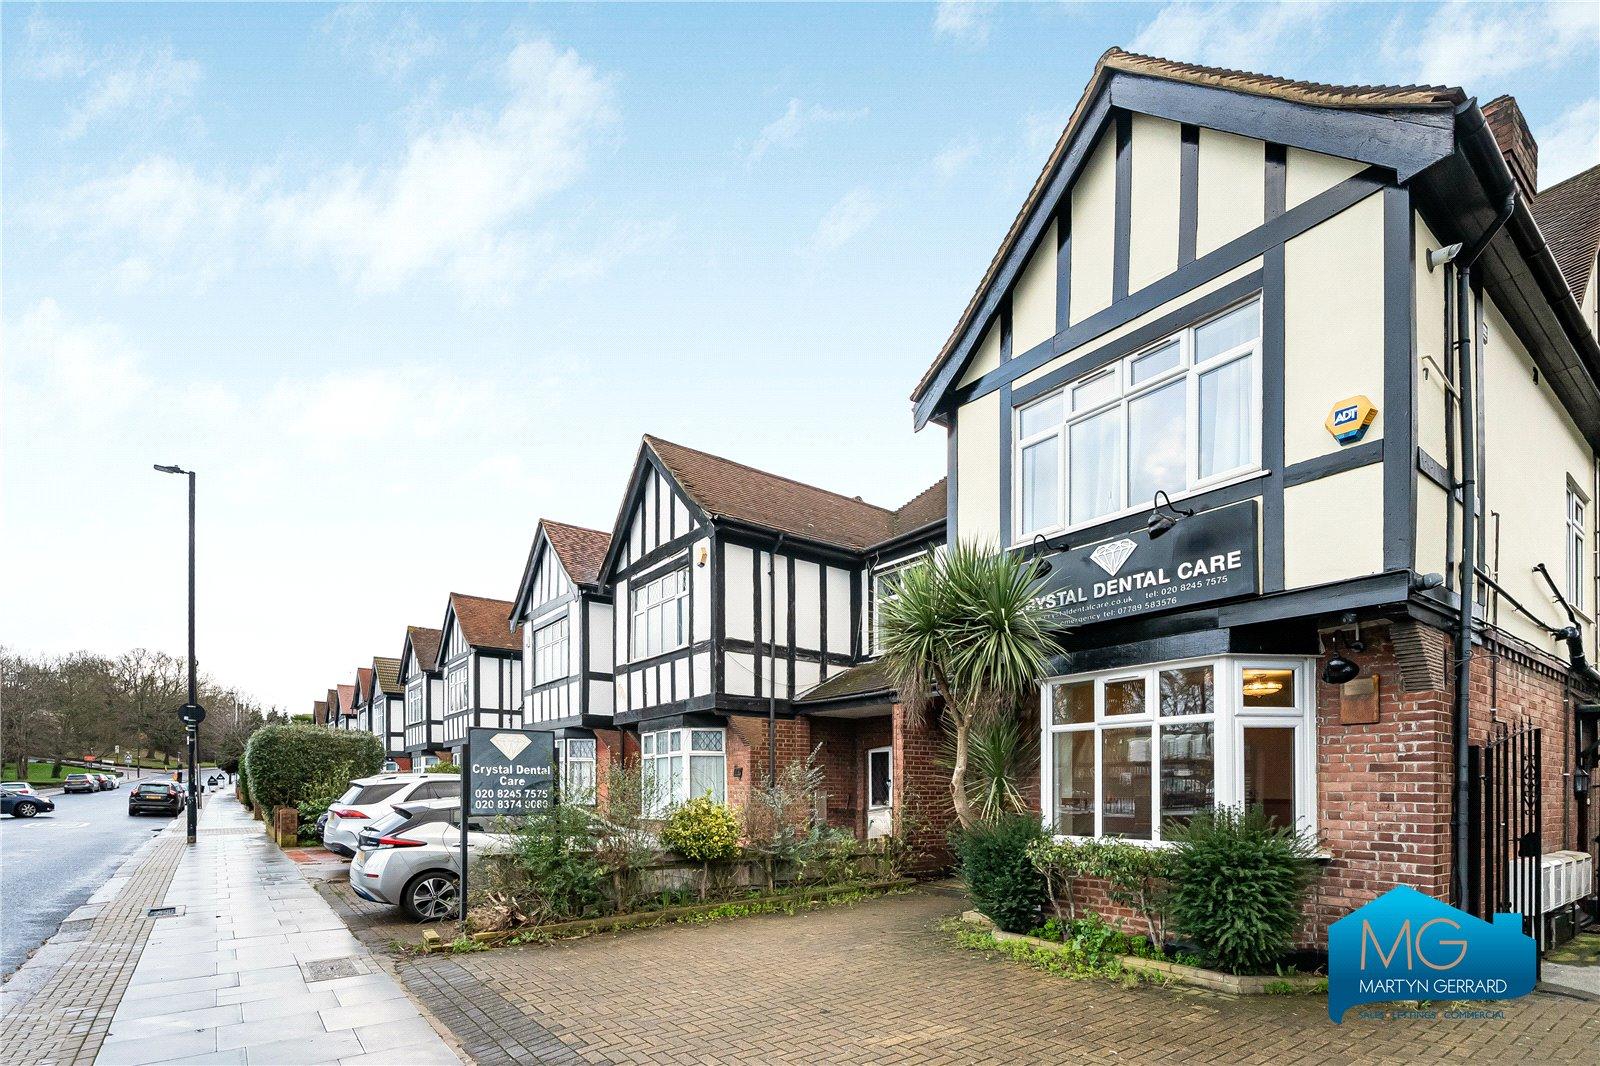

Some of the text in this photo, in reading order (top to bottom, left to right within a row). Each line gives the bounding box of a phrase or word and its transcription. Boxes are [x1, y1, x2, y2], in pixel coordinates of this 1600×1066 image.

[1335, 408, 1356, 423] ADT
[1093, 568, 1170, 599] DENTAL
[1177, 550, 1242, 580] CARE
[1145, 590, 1159, 599] tel:
[1161, 585, 1178, 596] 020
[1180, 580, 1203, 592] 8245
[1206, 575, 1228, 587] 7575
[1060, 597, 1177, 627] emergency tel: 07789 583576
[472, 763, 551, 776] Crystal Dental
[499, 776, 526, 786] Care
[475, 788, 548, 799] 020 8245 7575
[475, 800, 494, 809] 020
[497, 799, 522, 809] 8374
